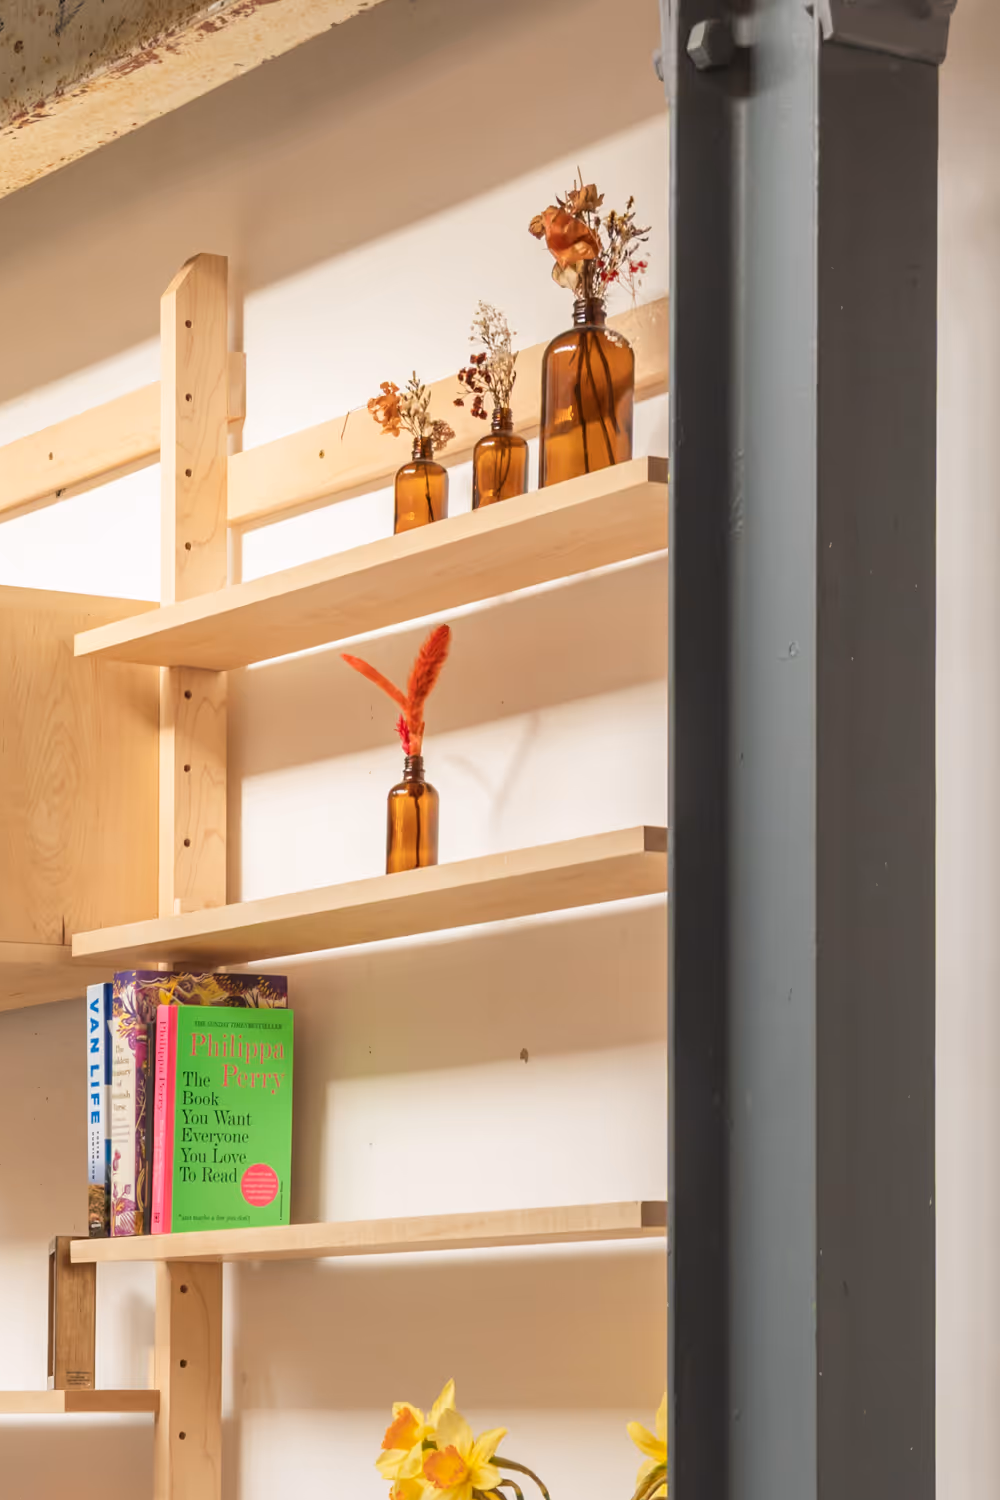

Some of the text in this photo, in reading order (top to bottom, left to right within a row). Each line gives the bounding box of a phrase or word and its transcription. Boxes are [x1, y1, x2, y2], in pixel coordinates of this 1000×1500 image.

[157, 1021, 167, 1074] Philippa
[189, 1032, 284, 1065] Philippa
[89, 997, 101, 1125] VAN LIFE
[182, 1070, 211, 1088] The
[221, 1063, 287, 1095] Perry
[183, 1090, 220, 1106] Book
[181, 1109, 253, 1126] You Want
[181, 1127, 250, 1147] Everyone
[180, 1147, 248, 1164] You Love
[179, 1166, 238, 1184] To Read
